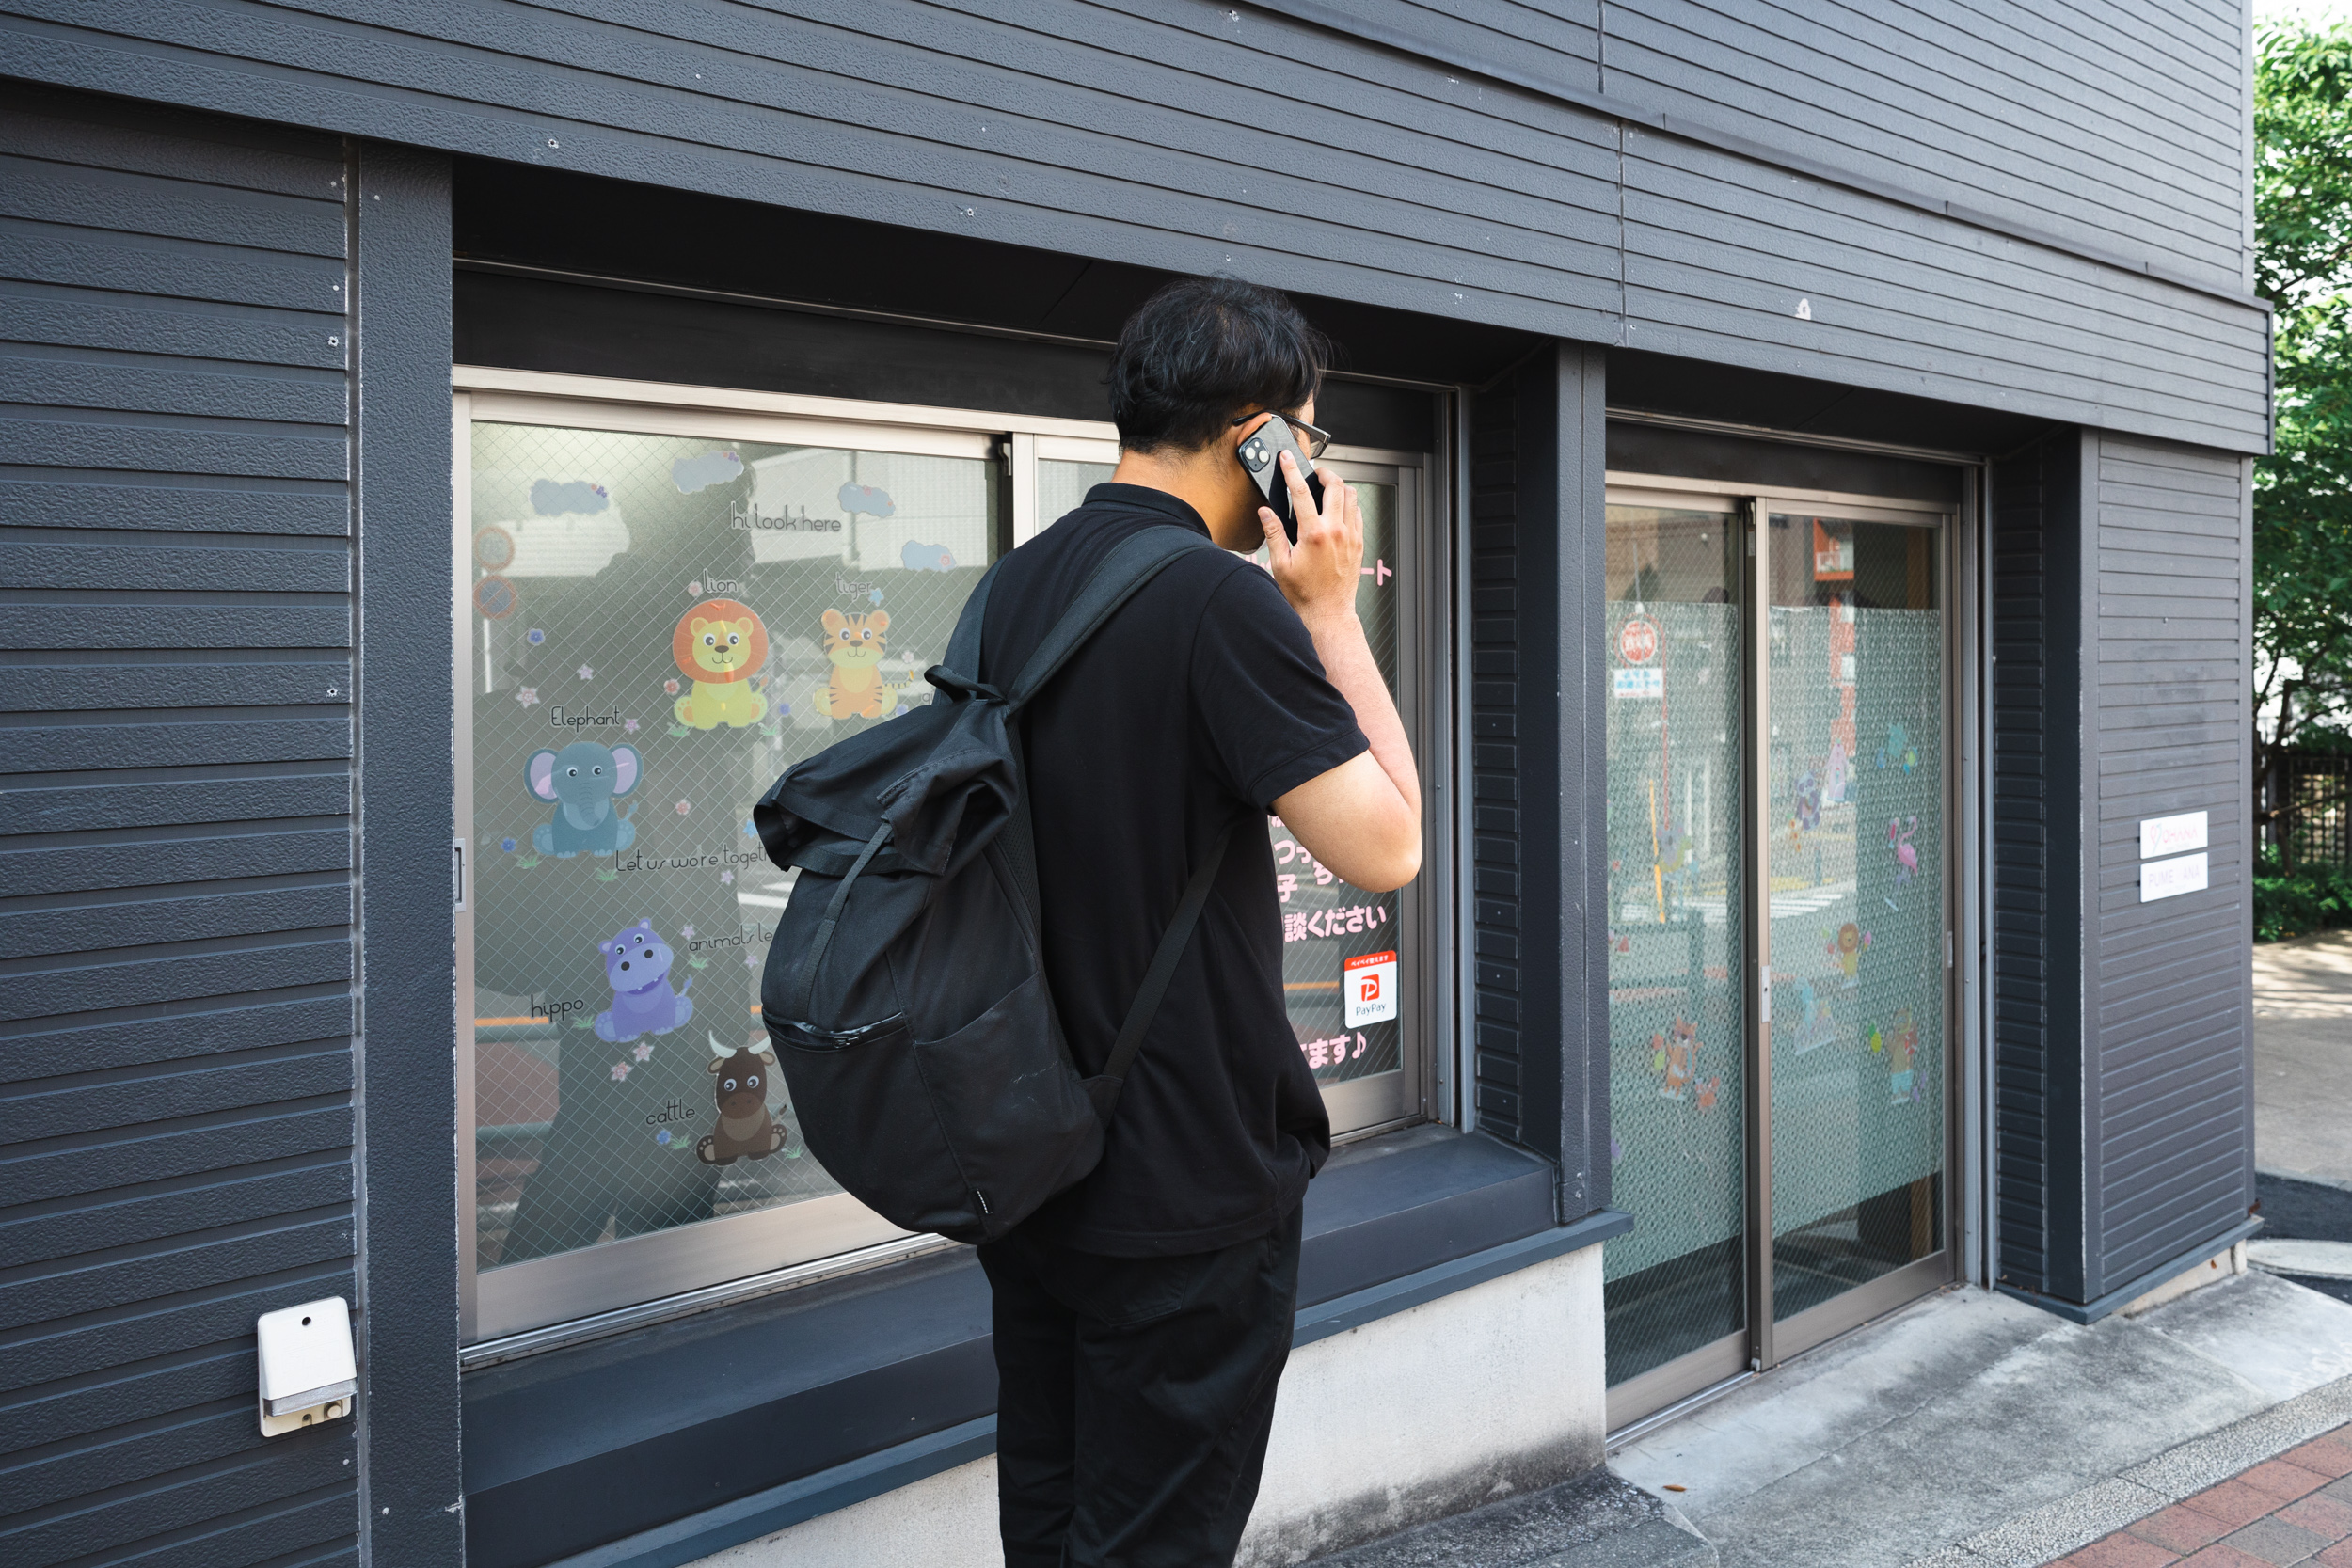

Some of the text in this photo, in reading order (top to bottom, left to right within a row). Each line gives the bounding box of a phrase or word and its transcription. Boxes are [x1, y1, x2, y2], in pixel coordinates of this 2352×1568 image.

[732, 501, 842, 531] hi look here
[705, 569, 737, 593] lion
[835, 573, 872, 600] tiger
[551, 705, 620, 733] Elephant
[616, 849, 643, 872] Let
[646, 859, 666, 870] us
[671, 855, 719, 869] wore
[689, 925, 755, 952] animals
[531, 994, 584, 1023] hippo
[1356, 1003, 1387, 1017] PayPay
[645, 1098, 696, 1125] cattle
